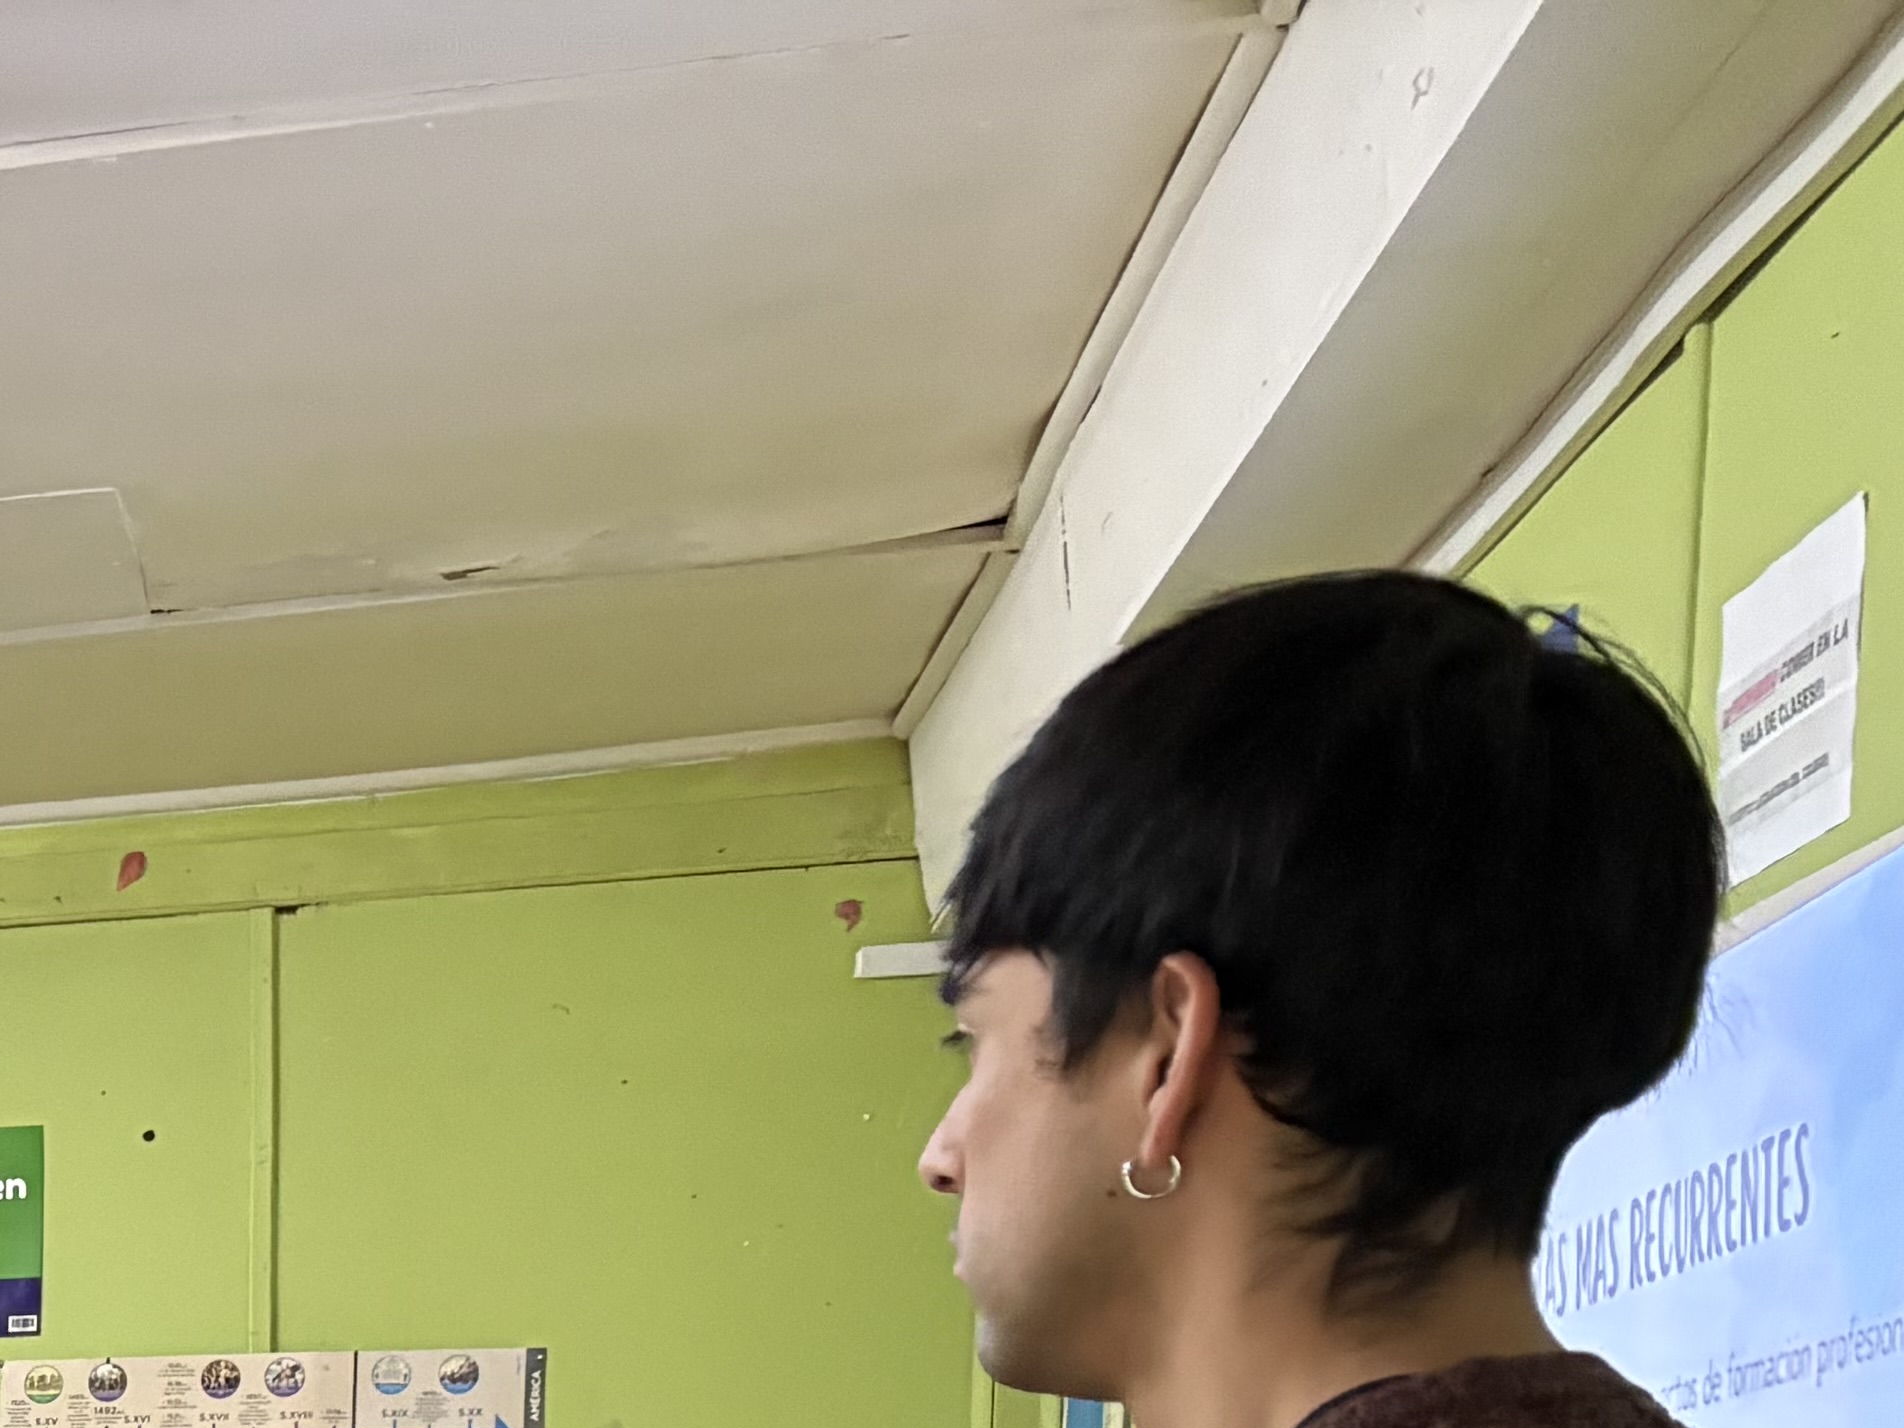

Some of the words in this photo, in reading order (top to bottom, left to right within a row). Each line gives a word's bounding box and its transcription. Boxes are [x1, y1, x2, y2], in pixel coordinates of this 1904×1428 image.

[1576, 1208, 1619, 1310] MAS
[1630, 1122, 1809, 1290] RECURRENTES
[1703, 1359, 1722, 1404] de
